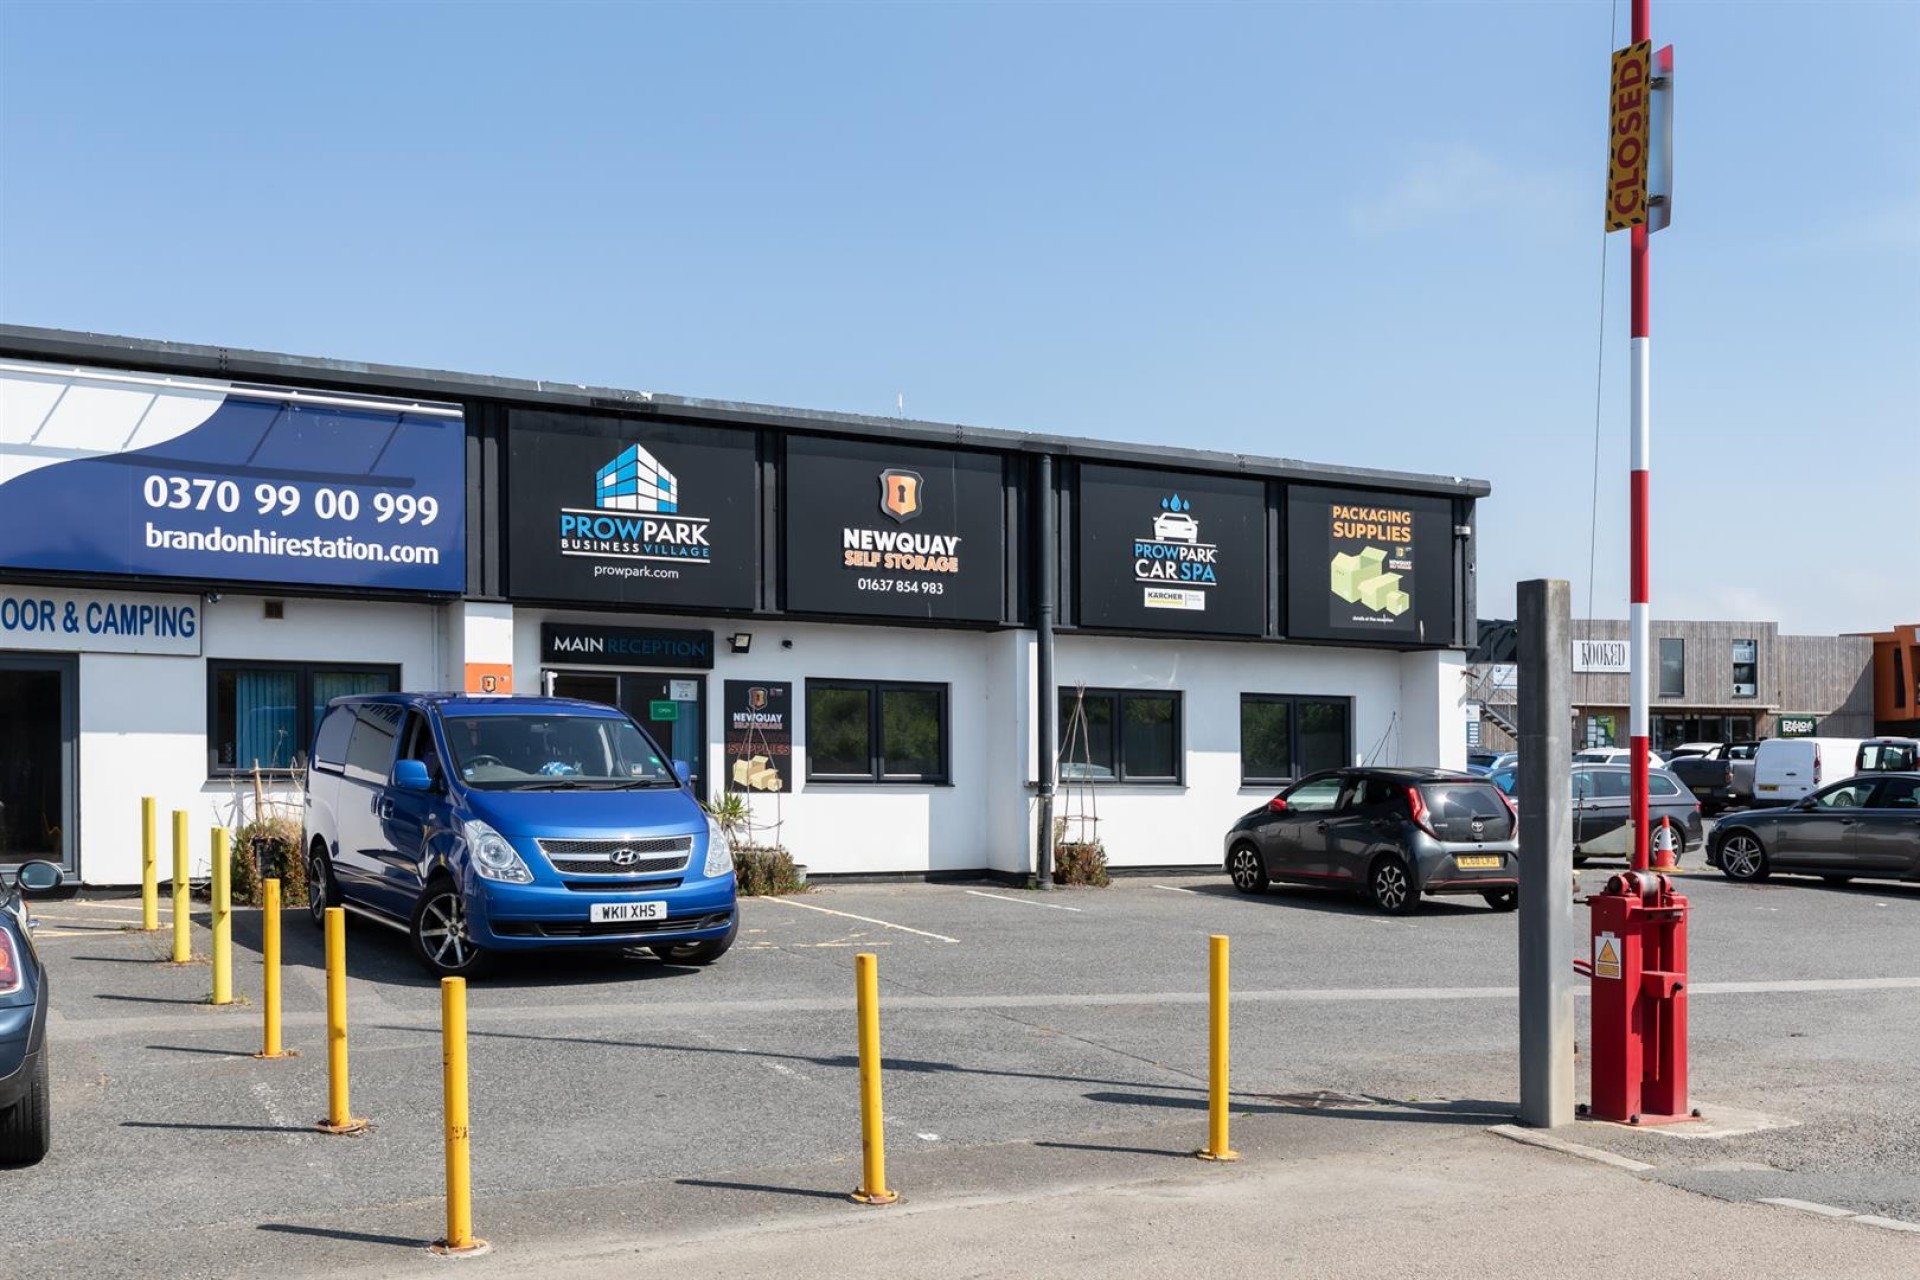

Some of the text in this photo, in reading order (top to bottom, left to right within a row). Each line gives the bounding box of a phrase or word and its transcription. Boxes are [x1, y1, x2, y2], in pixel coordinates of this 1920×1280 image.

[1614, 58, 1643, 215] CLOSED
[143, 475, 439, 526] 0370 99 00 999
[1332, 505, 1411, 524] PACKAGING
[561, 513, 708, 546] PROWPARK
[1333, 521, 1411, 543] SUPPLIES
[145, 522, 440, 565] brandonhirestation.com
[561, 538, 710, 558] BUSINESS VILLAGE
[843, 528, 958, 556] NEWQUAY
[594, 565, 679, 580] prowpark.com
[844, 551, 959, 573] SELF STORAGE
[1134, 558, 1216, 582] CAR SPA
[858, 578, 944, 595] 01637 854 983
[62, 602, 80, 634] &
[85, 602, 196, 638] CAMPING
[553, 636, 706, 657] MAIN RECEPTION
[733, 712, 782, 723] NEWQUAY
[728, 742, 790, 755] SUPPLIES
[602, 904, 656, 919] WK11 XHS
